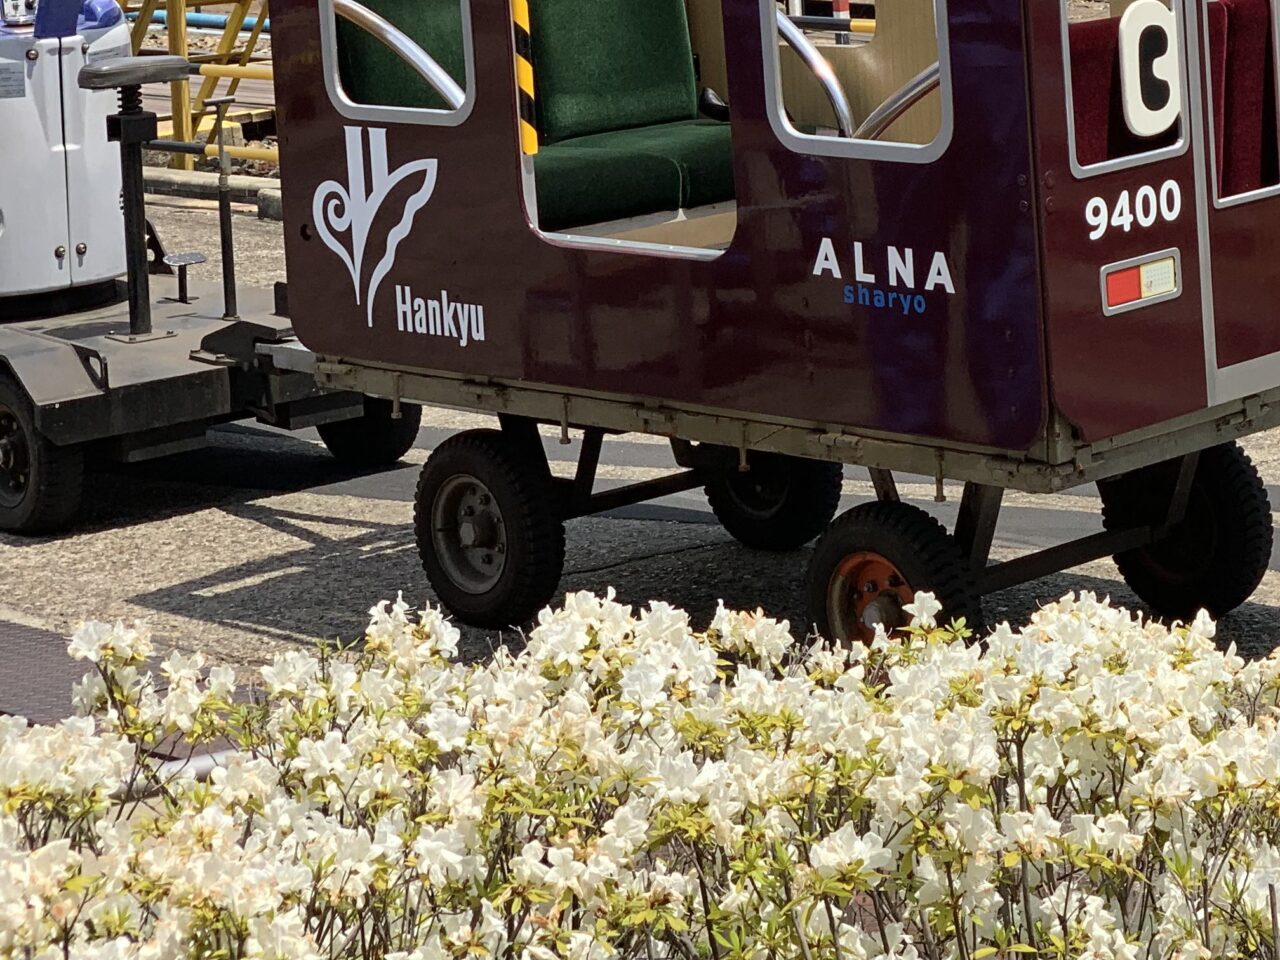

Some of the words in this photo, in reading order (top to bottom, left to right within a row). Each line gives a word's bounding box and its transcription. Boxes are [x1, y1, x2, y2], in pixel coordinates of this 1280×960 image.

[1085, 179, 1181, 240] 9400
[812, 237, 956, 294] ALNA
[395, 285, 485, 347] Hankyu
[843, 284, 927, 315] sharyo
